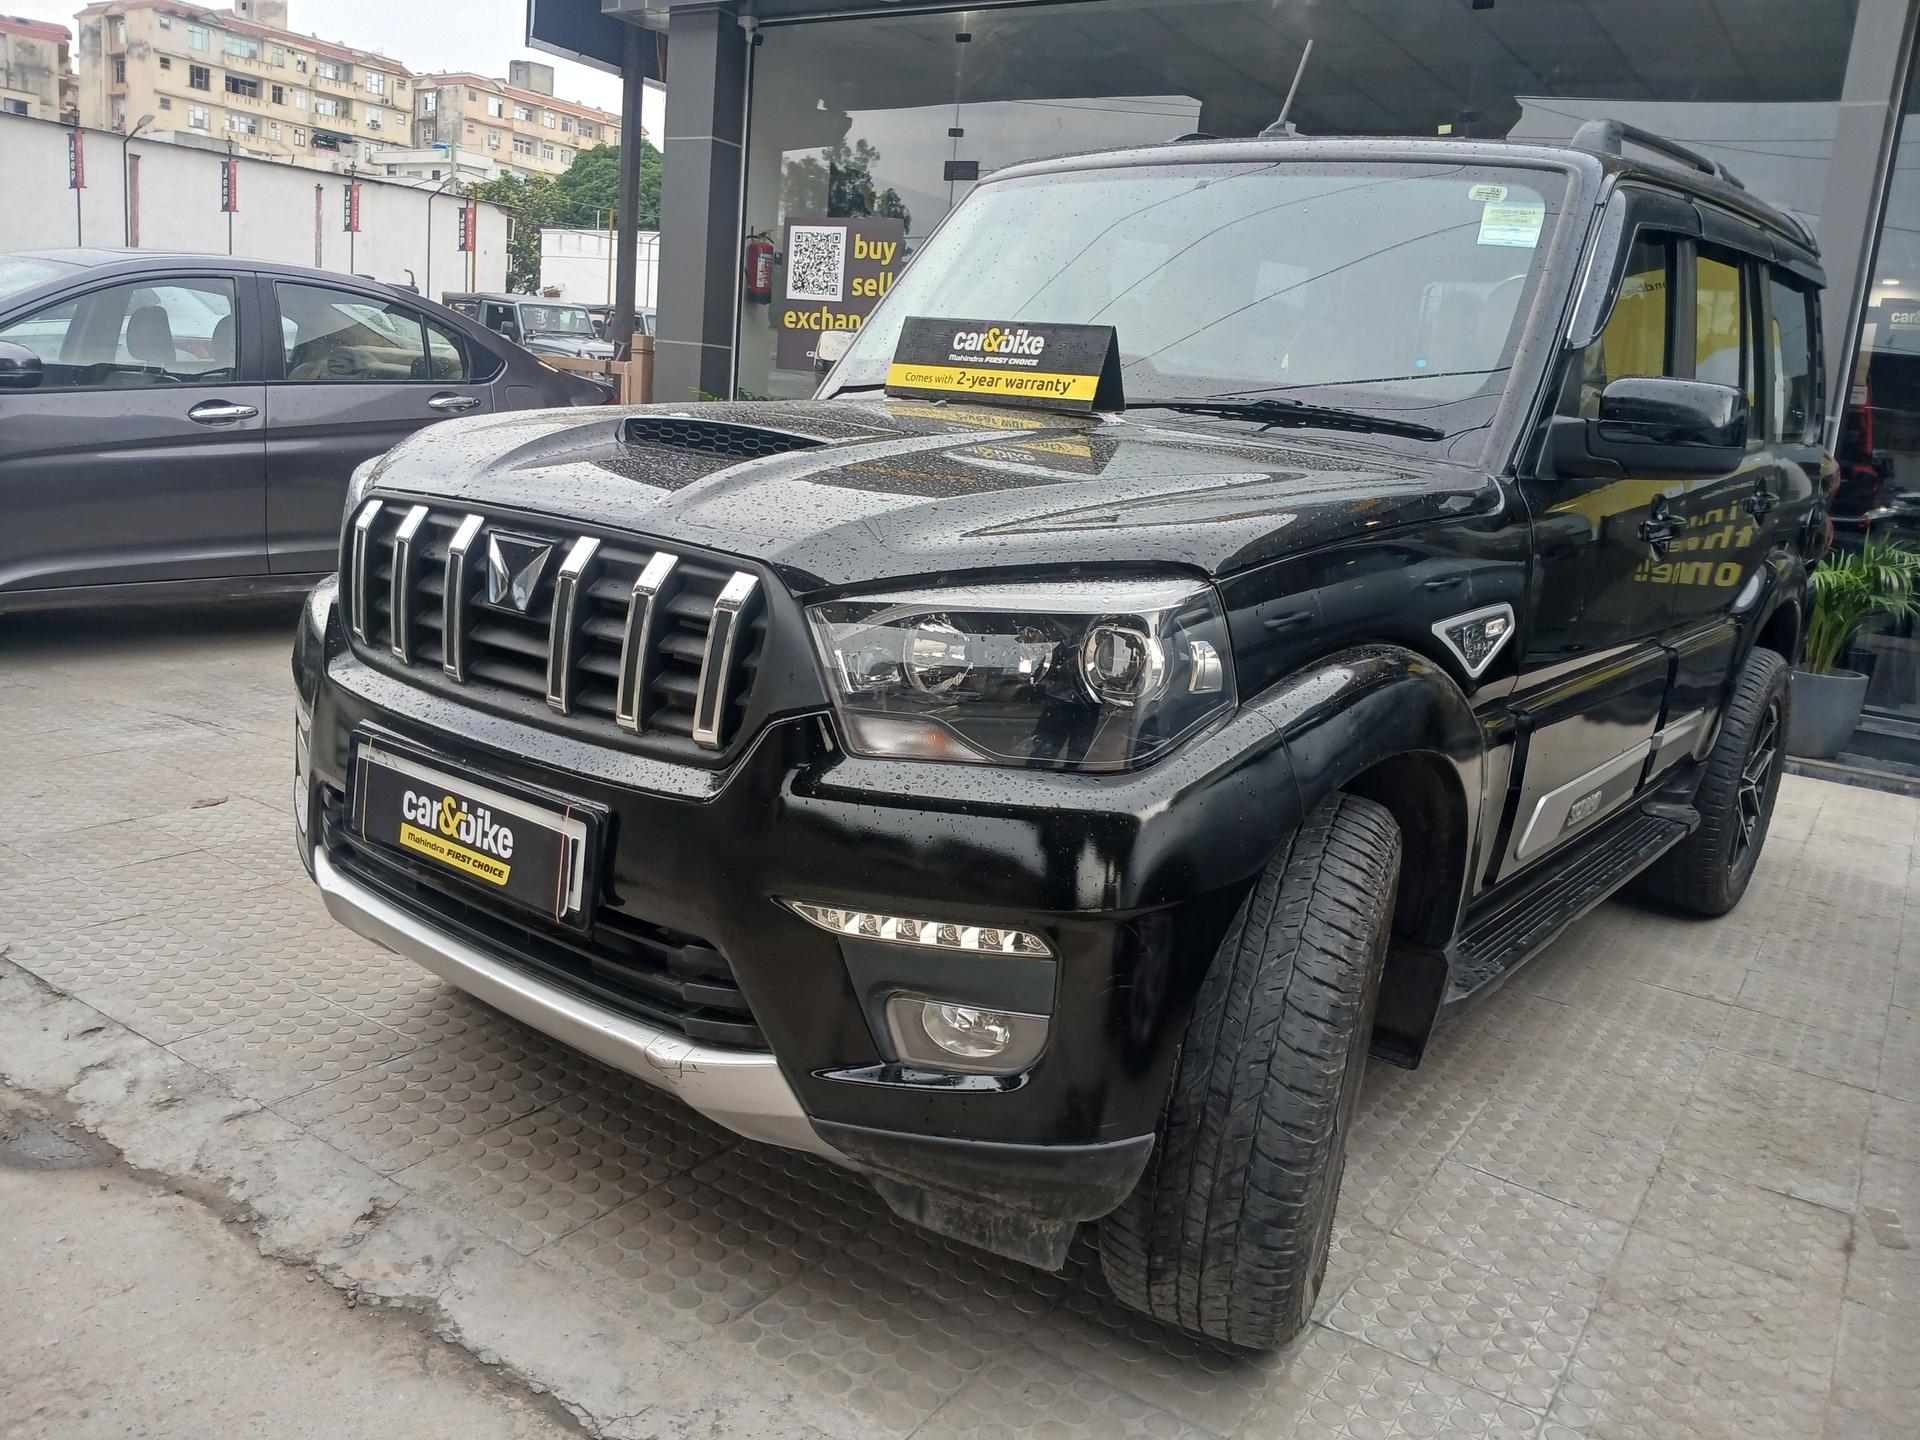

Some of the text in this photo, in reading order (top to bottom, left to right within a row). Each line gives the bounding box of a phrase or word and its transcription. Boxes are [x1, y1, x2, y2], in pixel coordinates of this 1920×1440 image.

[854, 233, 897, 266] buy
[851, 271, 893, 297] sell
[1890, 311, 1920, 324] car
[953, 328, 1045, 355] car&bike
[948, 354, 1040, 367] Mahindra FIRST CHOICE
[904, 371, 933, 384] Comes
[934, 373, 954, 384] with
[956, 371, 1002, 389] 2-year
[402, 790, 514, 859] car&bike
[407, 831, 505, 879] Mahindra FIRST CHOICE
